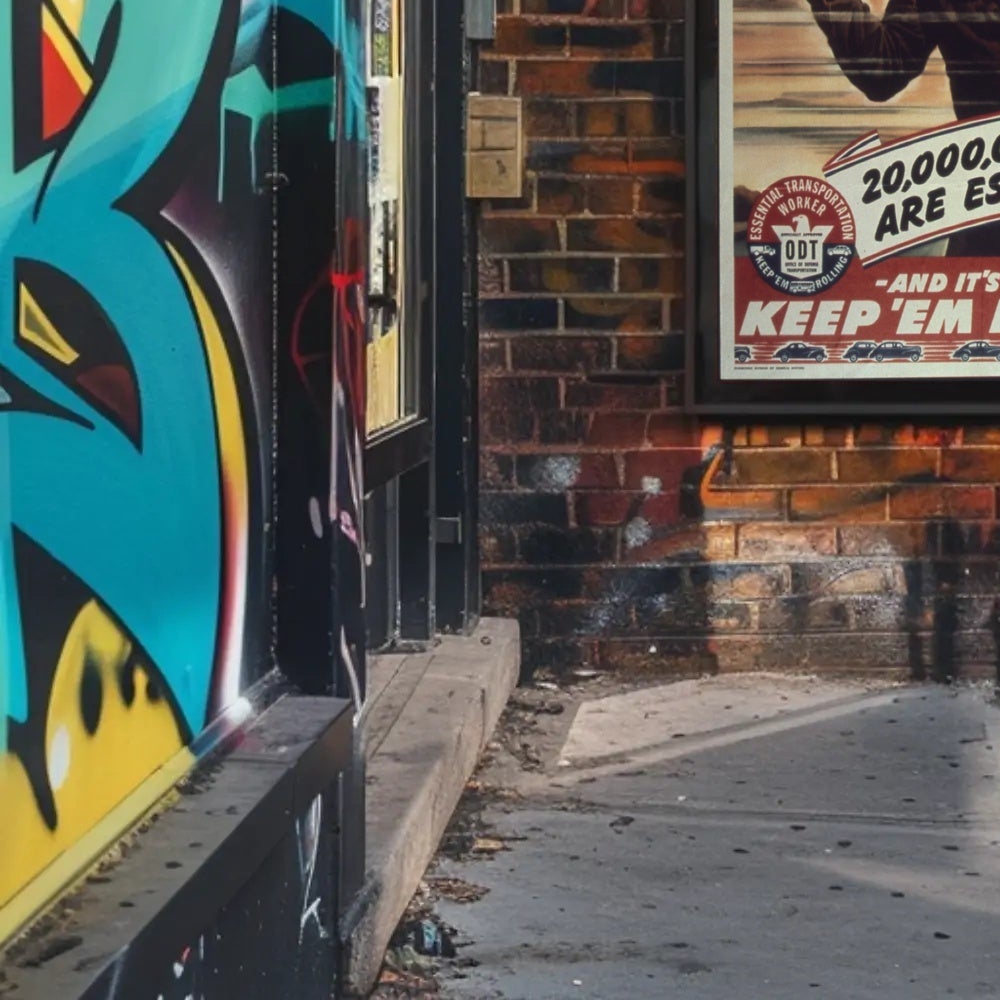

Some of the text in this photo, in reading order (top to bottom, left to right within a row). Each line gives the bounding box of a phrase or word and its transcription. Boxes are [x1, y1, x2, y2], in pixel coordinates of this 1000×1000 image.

[750, 179, 854, 240] ESSENTIAL TRANSPORTATION
[777, 197, 826, 216] WORKER
[874, 187, 947, 242] ARE
[785, 240, 818, 260] ODT
[755, 254, 849, 291] KEEP 'EM ROLLING
[954, 271, 1000, 293] IT'S
[738, 300, 881, 337] KEEP
[891, 299, 974, 336] 'EM
